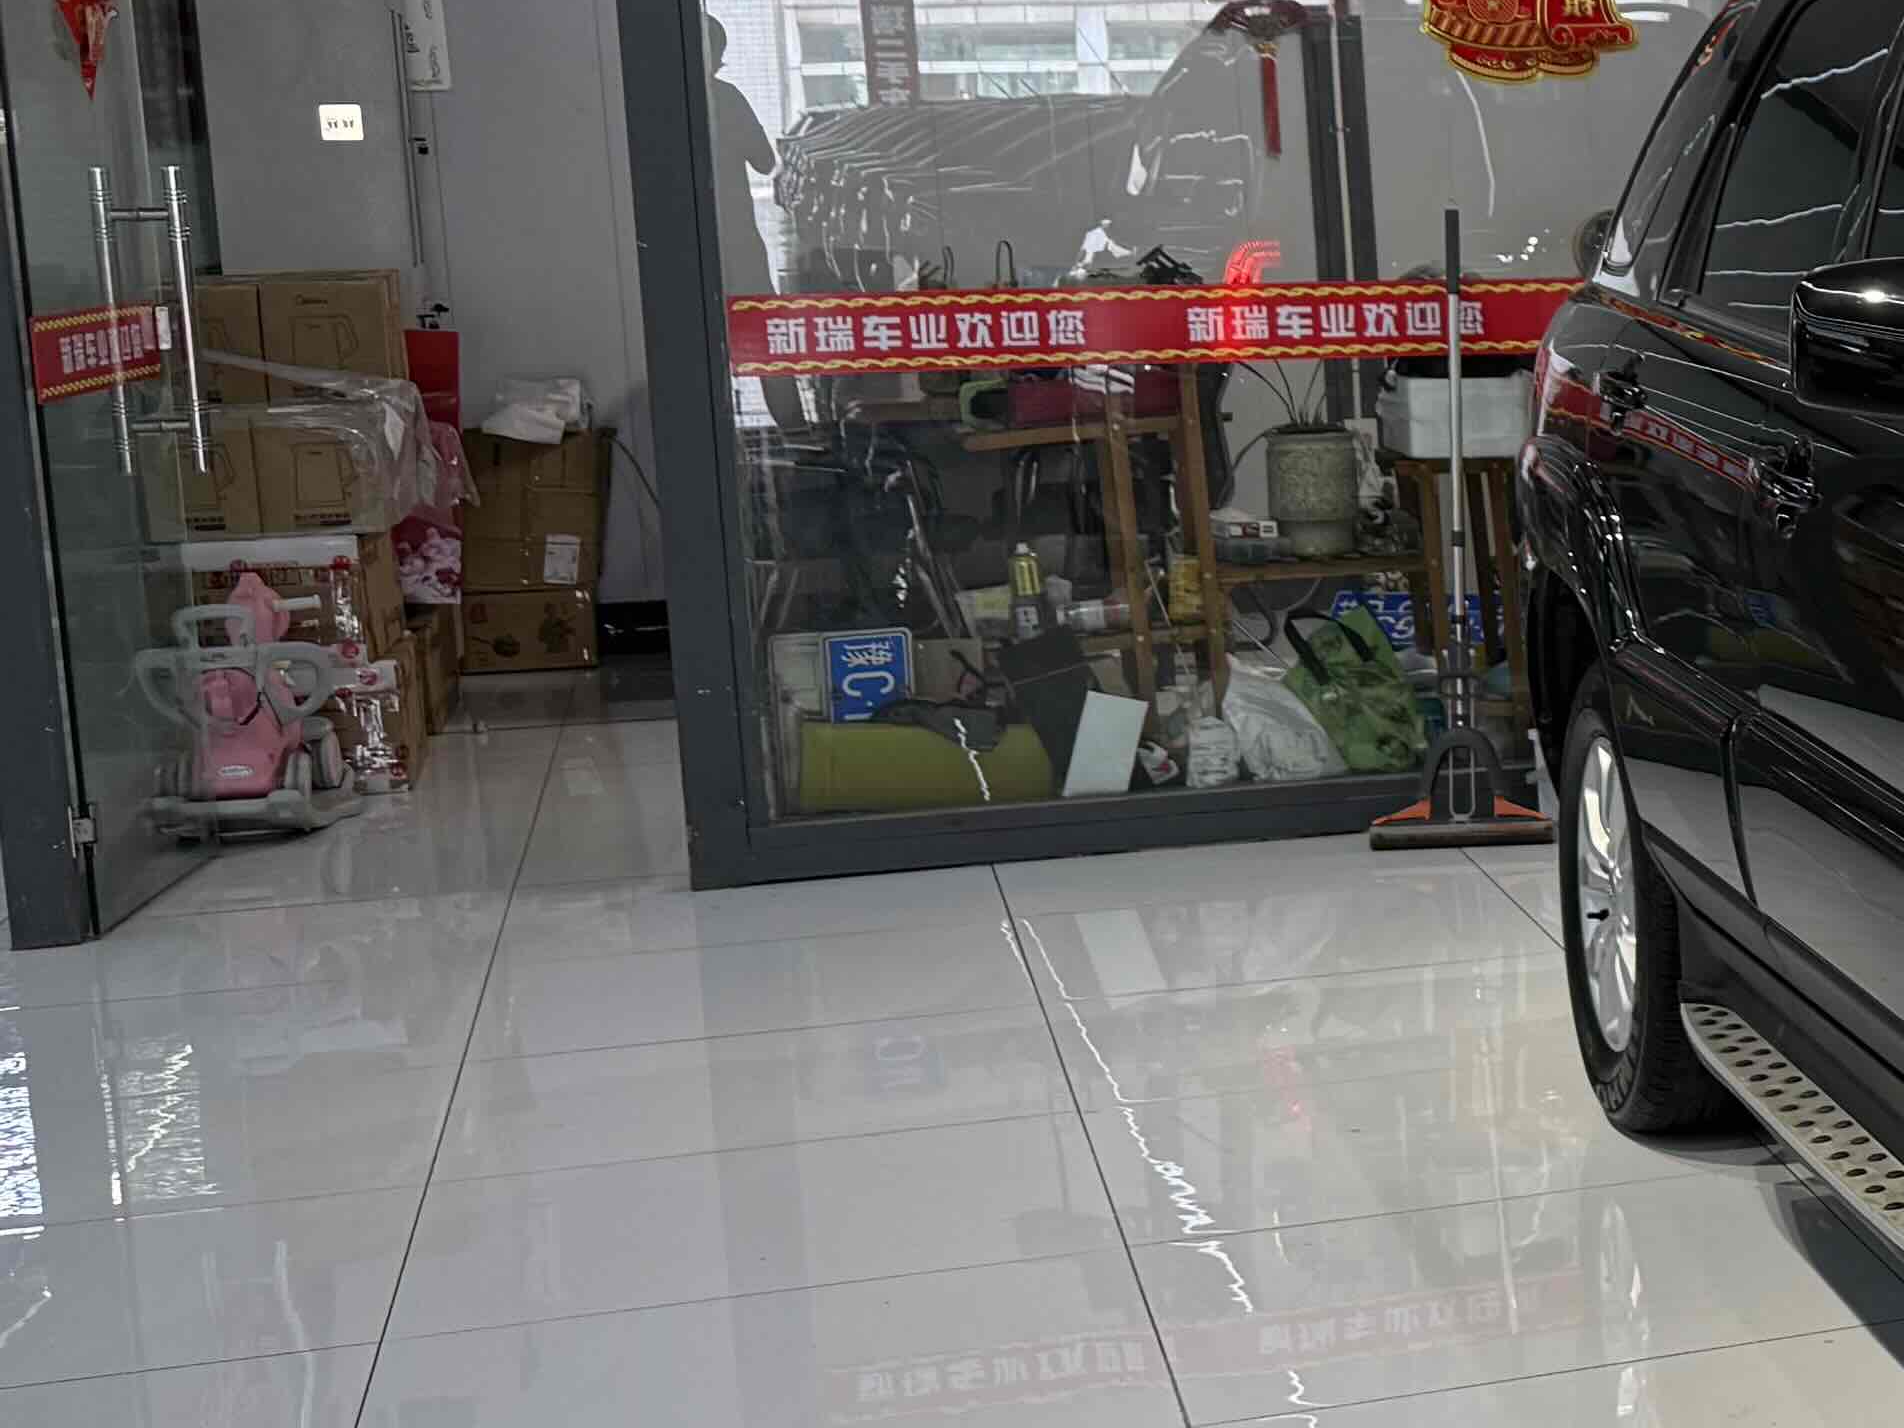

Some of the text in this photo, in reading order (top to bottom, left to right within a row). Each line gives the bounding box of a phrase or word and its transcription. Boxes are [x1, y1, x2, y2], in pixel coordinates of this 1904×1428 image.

[766, 308, 1087, 355] 新瑞车业欢迎您
[1186, 300, 1486, 343] 新瑞车业欢迎您
